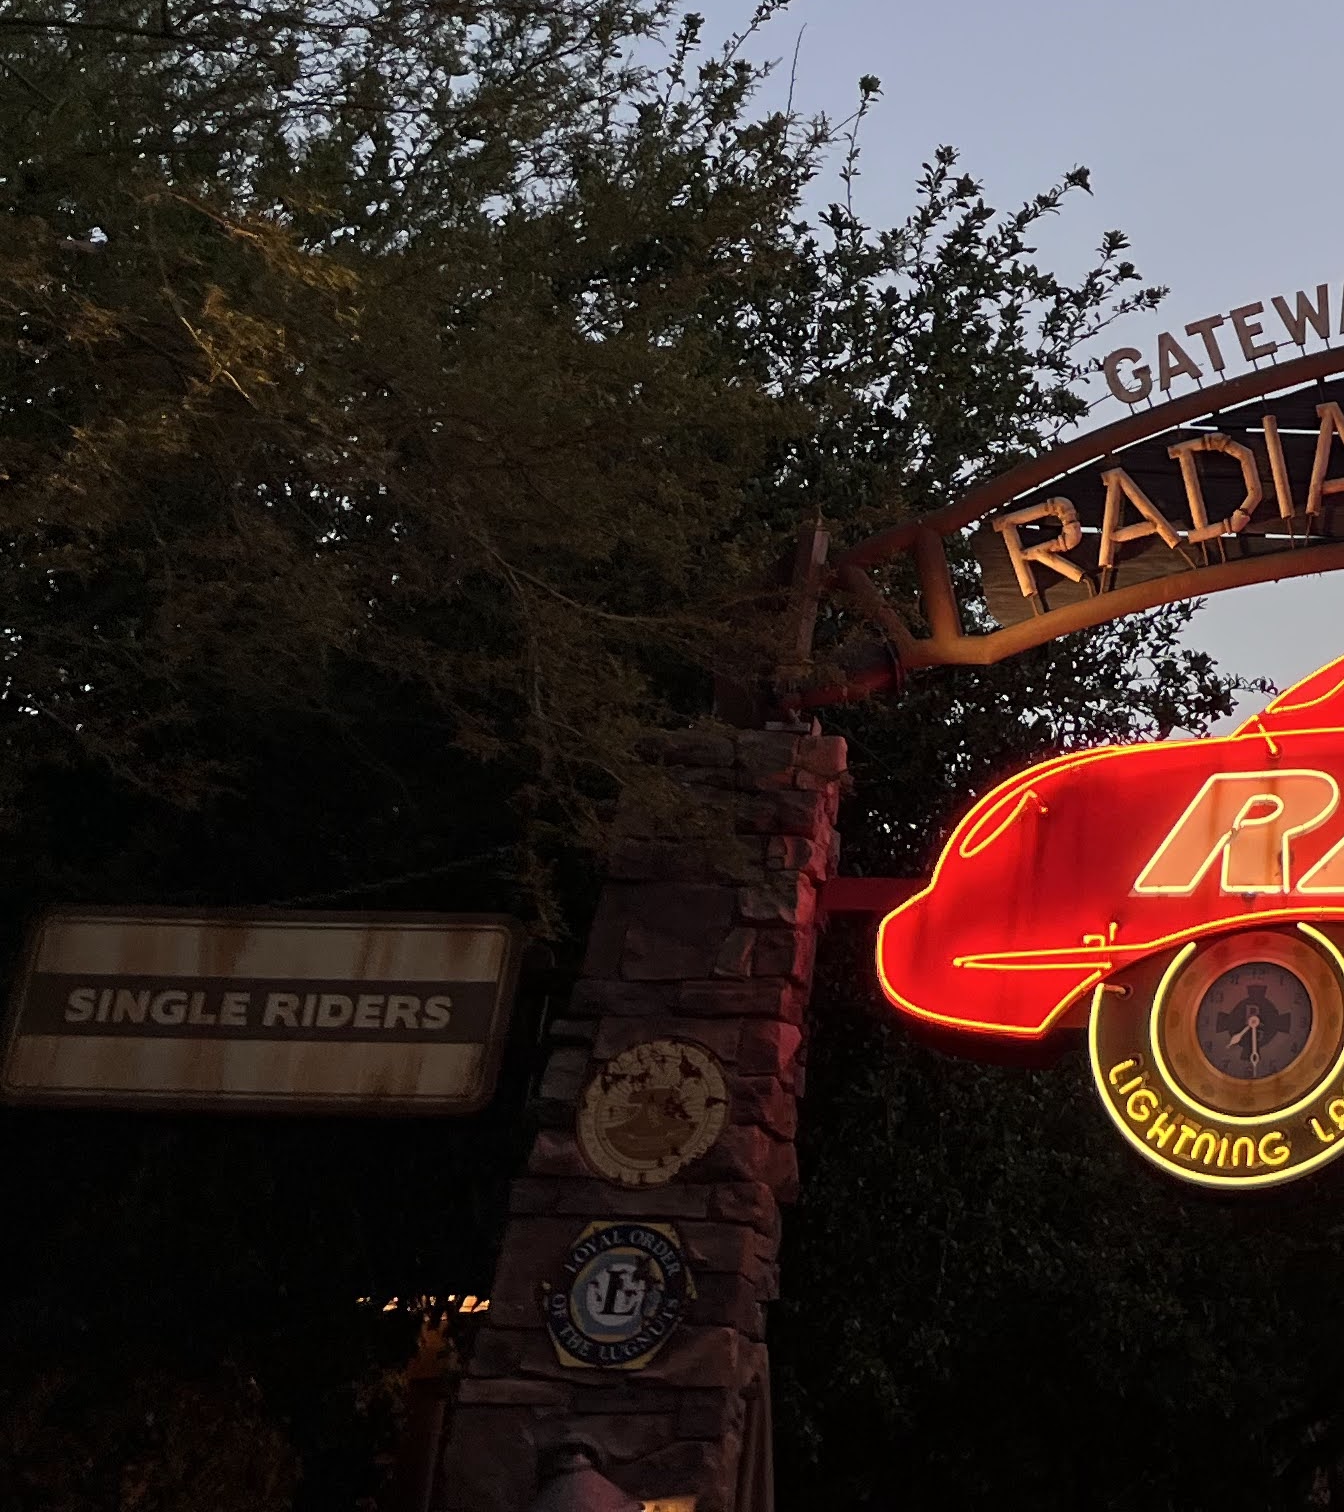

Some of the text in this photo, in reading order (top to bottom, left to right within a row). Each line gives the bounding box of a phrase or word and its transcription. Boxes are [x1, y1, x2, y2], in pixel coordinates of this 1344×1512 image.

[64, 987, 454, 1031] SINGLE RIDERS
[1108, 1057, 1292, 1168] LIGHTNING
[629, 1229, 682, 1276] ORDER
[559, 1322, 593, 1357] THE
